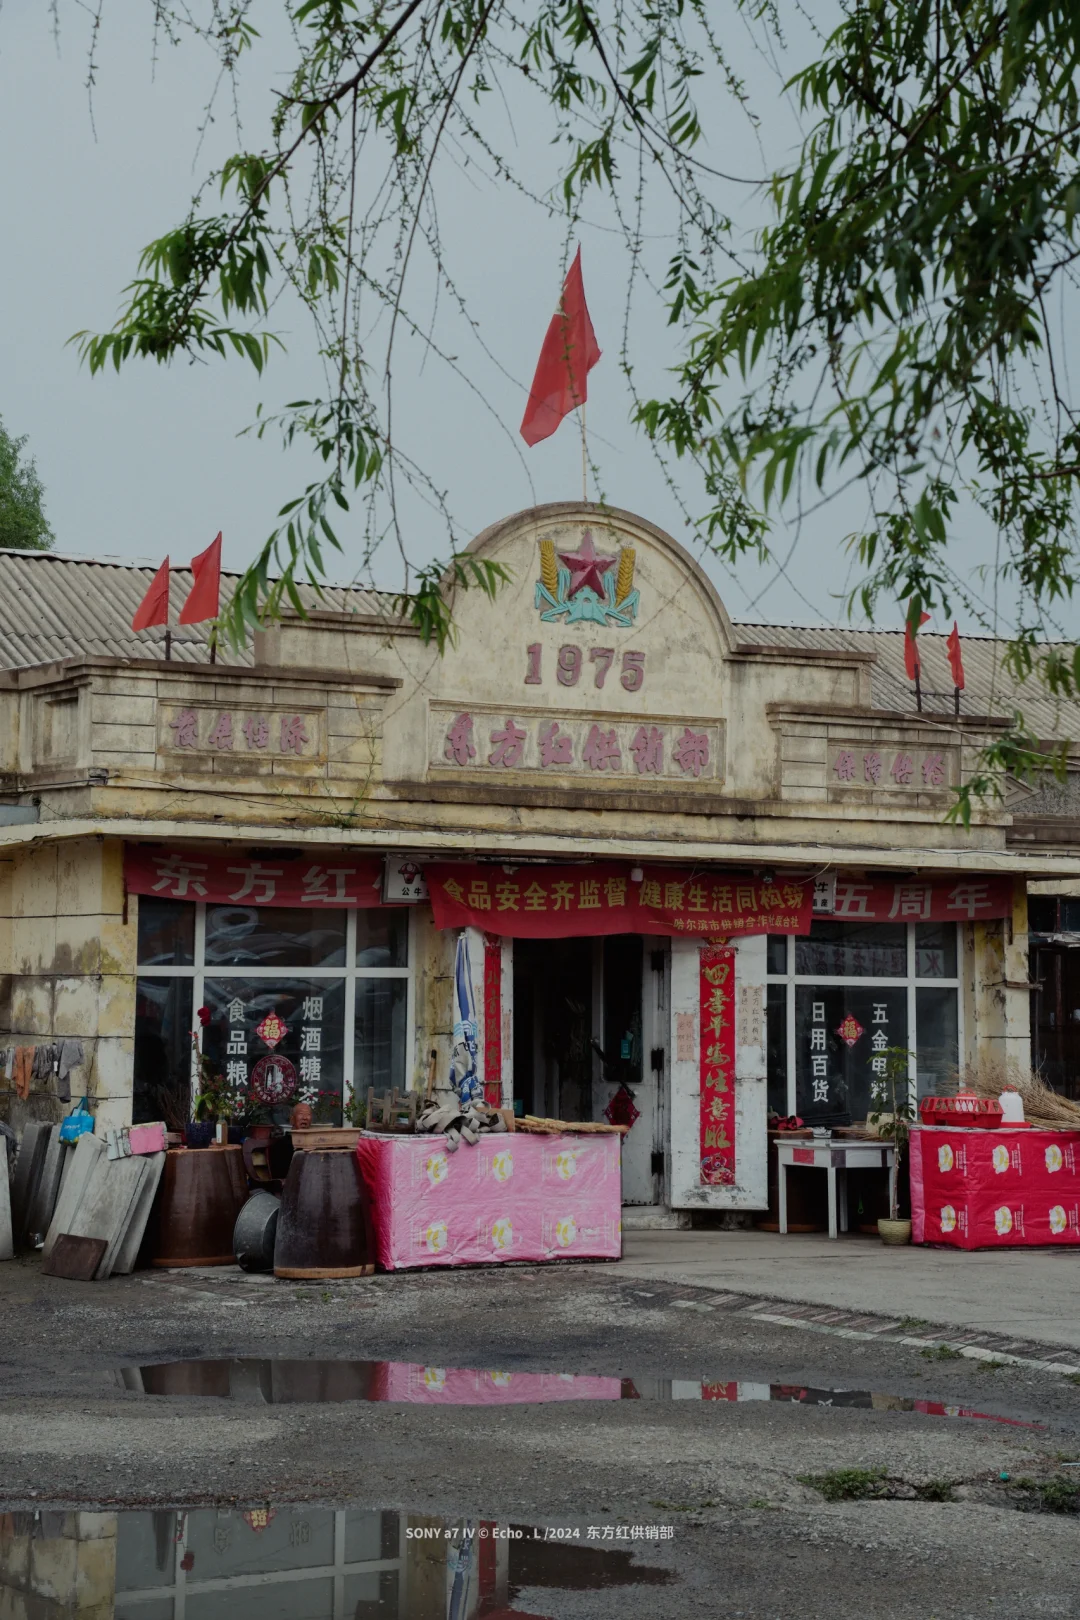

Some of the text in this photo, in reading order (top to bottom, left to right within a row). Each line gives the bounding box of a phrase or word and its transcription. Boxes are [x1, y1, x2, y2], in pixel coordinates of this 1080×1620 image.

[524, 643, 645, 691] 1975
[151, 854, 380, 903] 东方红
[442, 877, 804, 913] 食品安全齐监督 健康生活同构筑
[263, 1018, 280, 1039] 福
[810, 1002, 829, 1102] 日用百货
[844, 1021, 857, 1038] 福
[871, 1003, 889, 1102] 五金电料
[704, 963, 730, 1149] 四季平安生意旺
